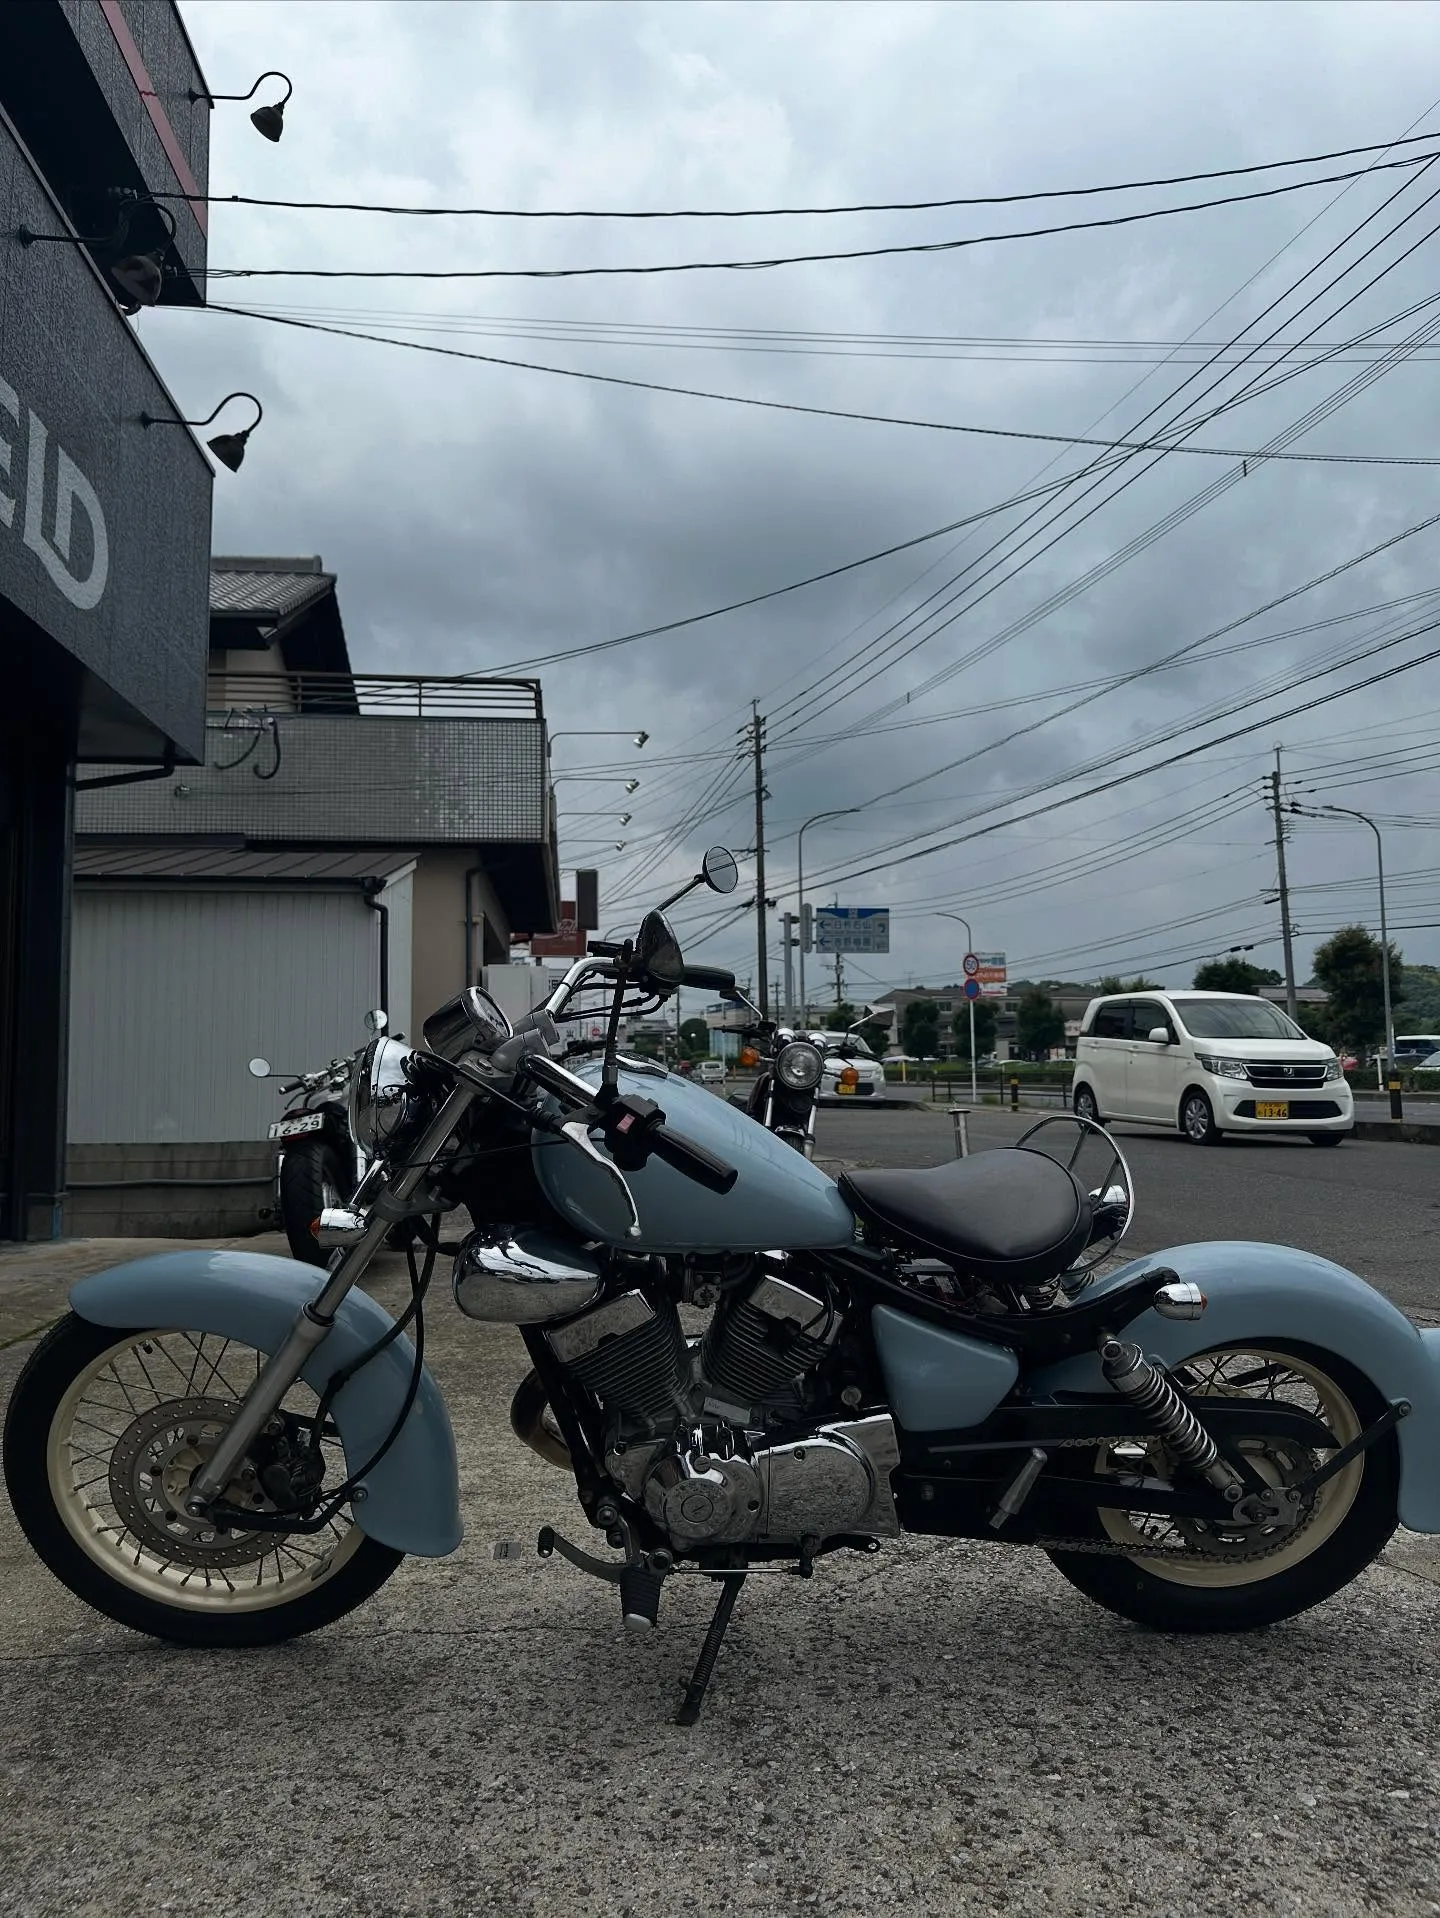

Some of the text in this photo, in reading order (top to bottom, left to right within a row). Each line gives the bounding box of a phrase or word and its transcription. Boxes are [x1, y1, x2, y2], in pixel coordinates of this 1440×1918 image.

[966, 960, 976, 970] 50
[1263, 1108, 1287, 1117] 13-46
[273, 1120, 320, 1137] 16-29
